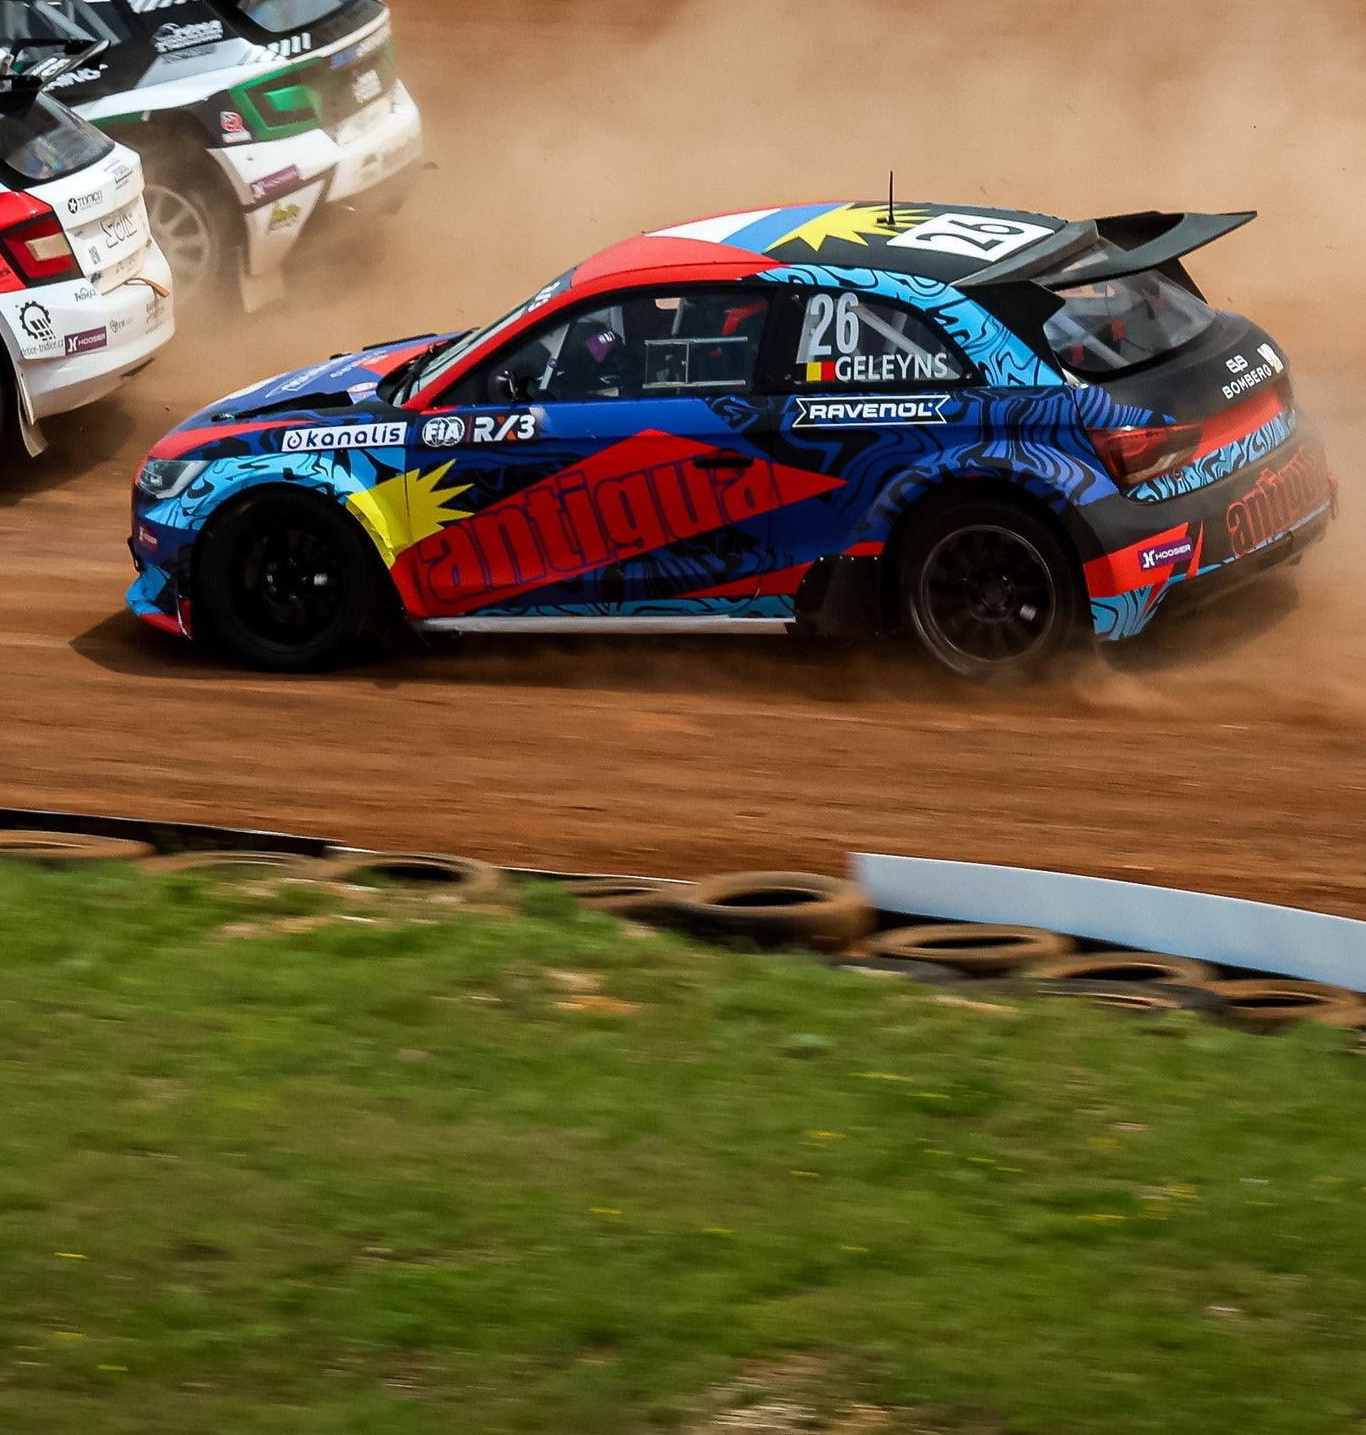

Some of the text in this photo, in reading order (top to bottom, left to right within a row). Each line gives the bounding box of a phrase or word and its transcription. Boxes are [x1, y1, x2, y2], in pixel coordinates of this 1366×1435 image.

[916, 220, 1026, 252] 26
[808, 291, 861, 356] 26
[835, 352, 949, 381] GELEYNS
[1221, 364, 1273, 400] BOMBERG
[809, 402, 934, 419] RAVENOL
[305, 424, 401, 449] kanalis
[425, 414, 536, 443] FIA RX3
[419, 450, 783, 604] antigua
[1155, 543, 1191, 562] HOOSIER
